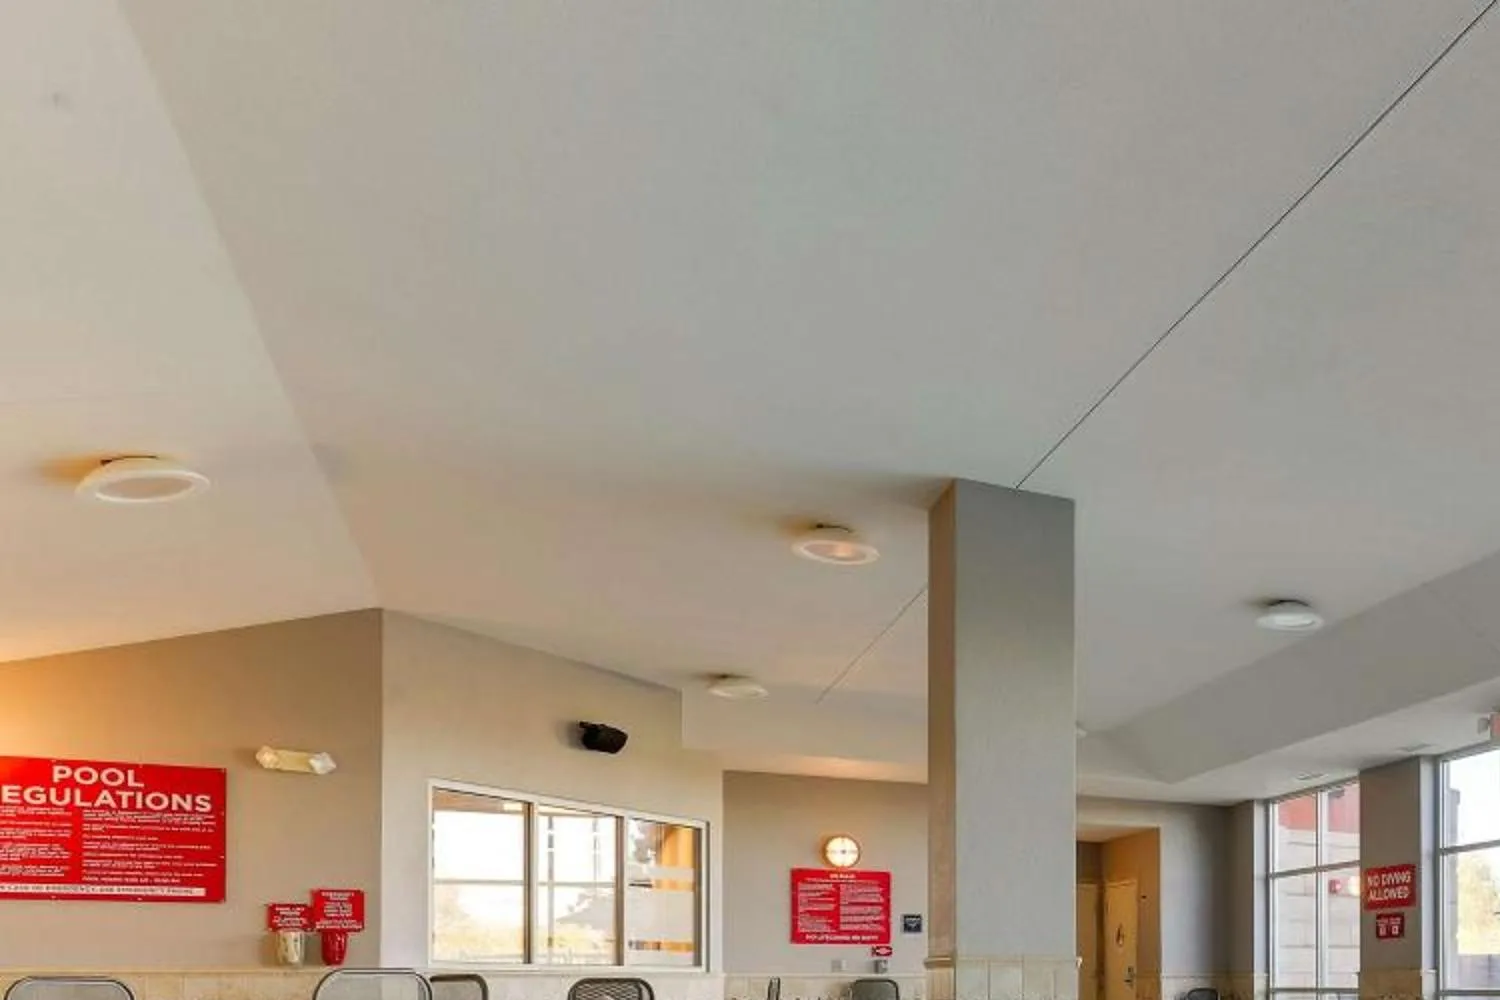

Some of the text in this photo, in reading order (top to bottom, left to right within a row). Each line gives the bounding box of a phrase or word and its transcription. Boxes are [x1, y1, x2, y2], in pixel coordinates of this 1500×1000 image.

[53, 765, 144, 788] POOL
[1, 785, 212, 812] EGULATIONS
[1367, 875, 1380, 887] NO
